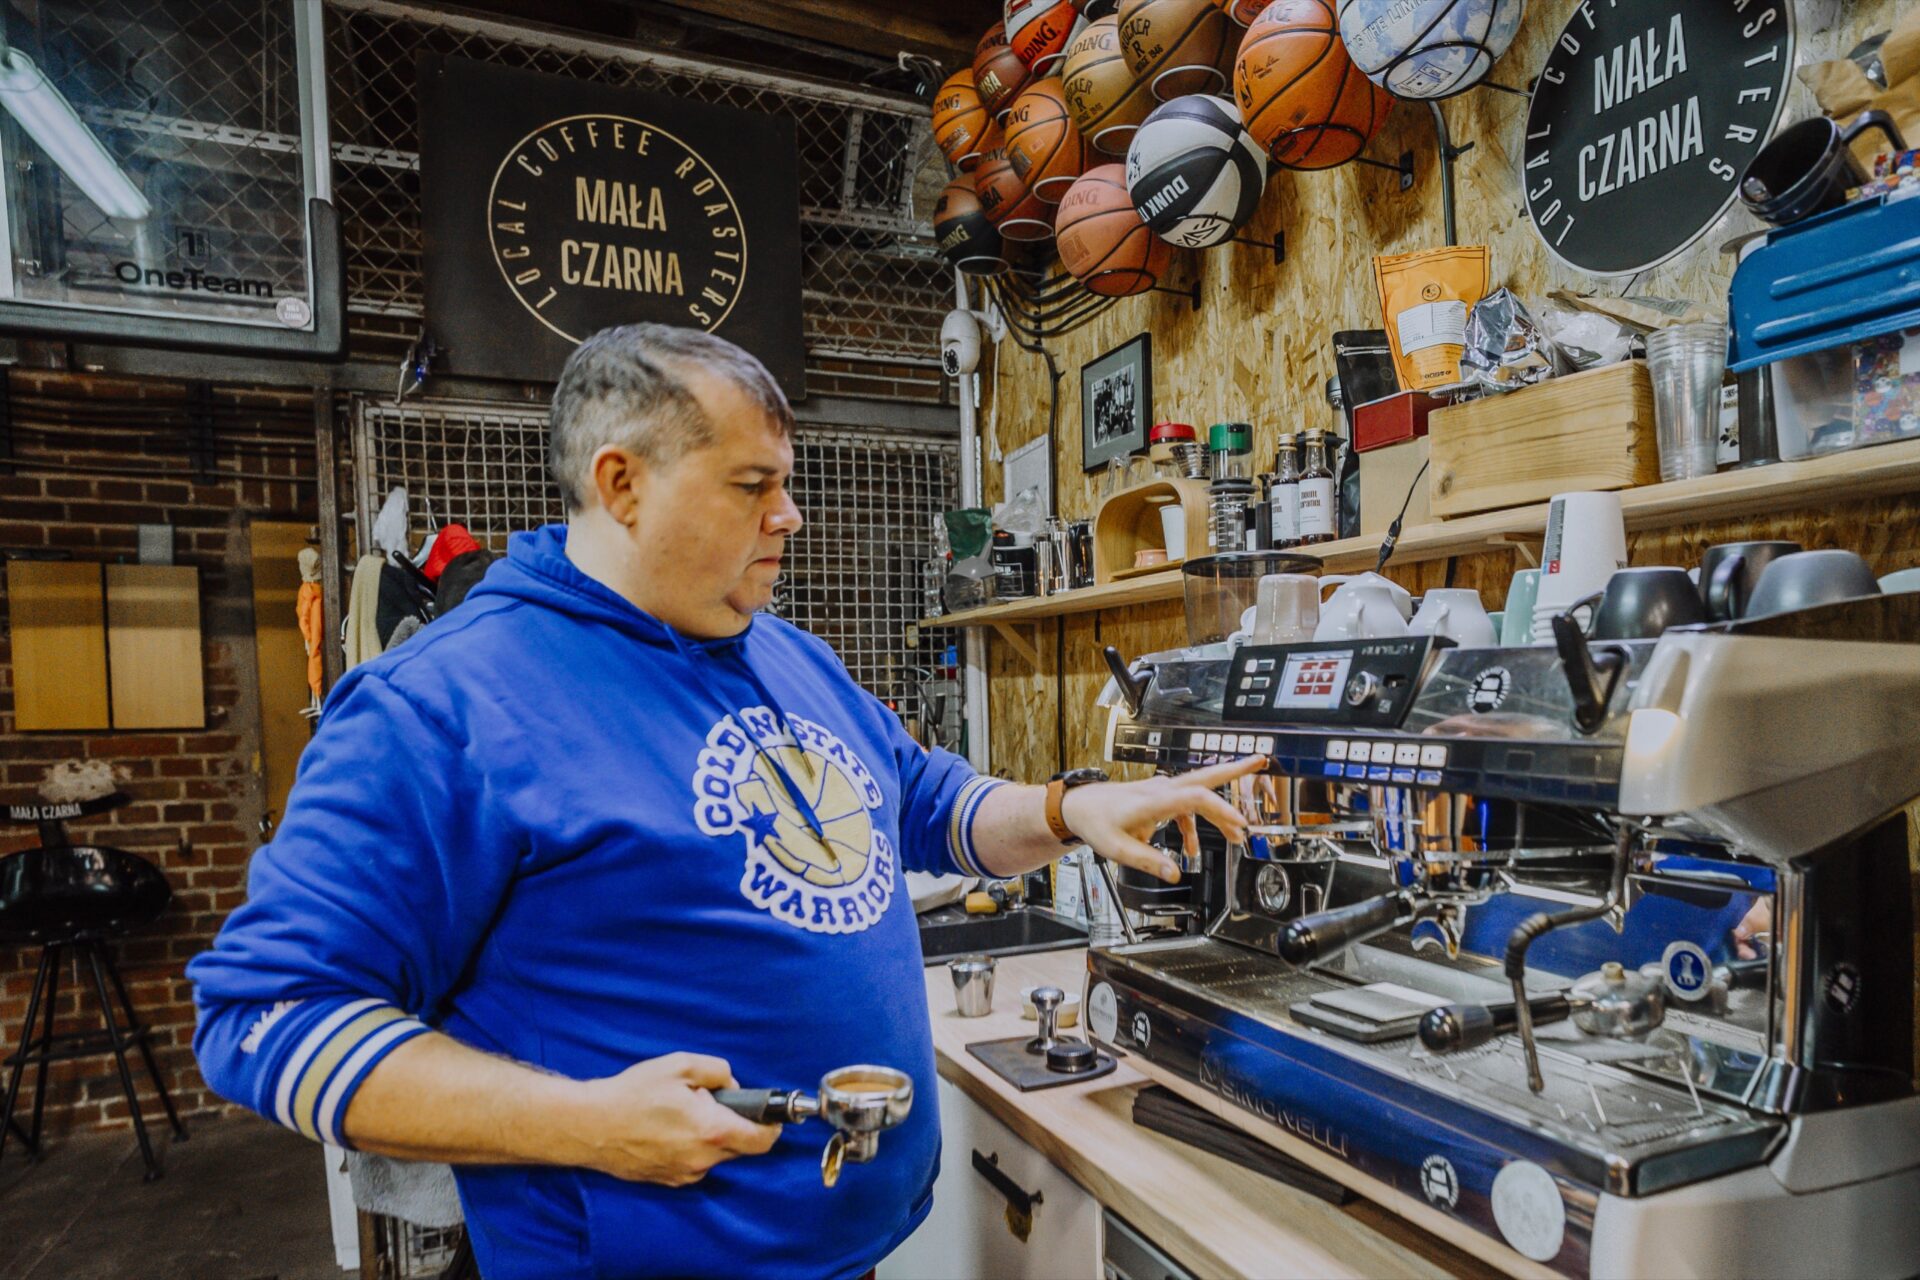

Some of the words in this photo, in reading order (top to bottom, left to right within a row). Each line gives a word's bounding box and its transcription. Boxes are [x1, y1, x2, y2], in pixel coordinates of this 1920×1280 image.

[1132, 40, 1146, 58] R
[1593, 13, 1688, 115] MAŁA
[516, 121, 652, 178] COFFEE
[1526, 123, 1575, 247] LOCAL
[1578, 95, 1704, 202] CZARNA
[575, 176, 667, 232] MAŁA
[1145, 174, 1190, 217] DUNK
[115, 261, 273, 298] OneTeam
[496, 199, 558, 310] LOCAL
[560, 239, 685, 297] CZARNA
[674, 156, 740, 327] ROASTERS
[791, 718, 881, 805] STATE
[10, 805, 39, 820] MAŁA
[41, 803, 82, 820] CZARNA
[750, 834, 895, 925] WARRIORS
[1220, 1080, 1350, 1159] SIMONELLI
